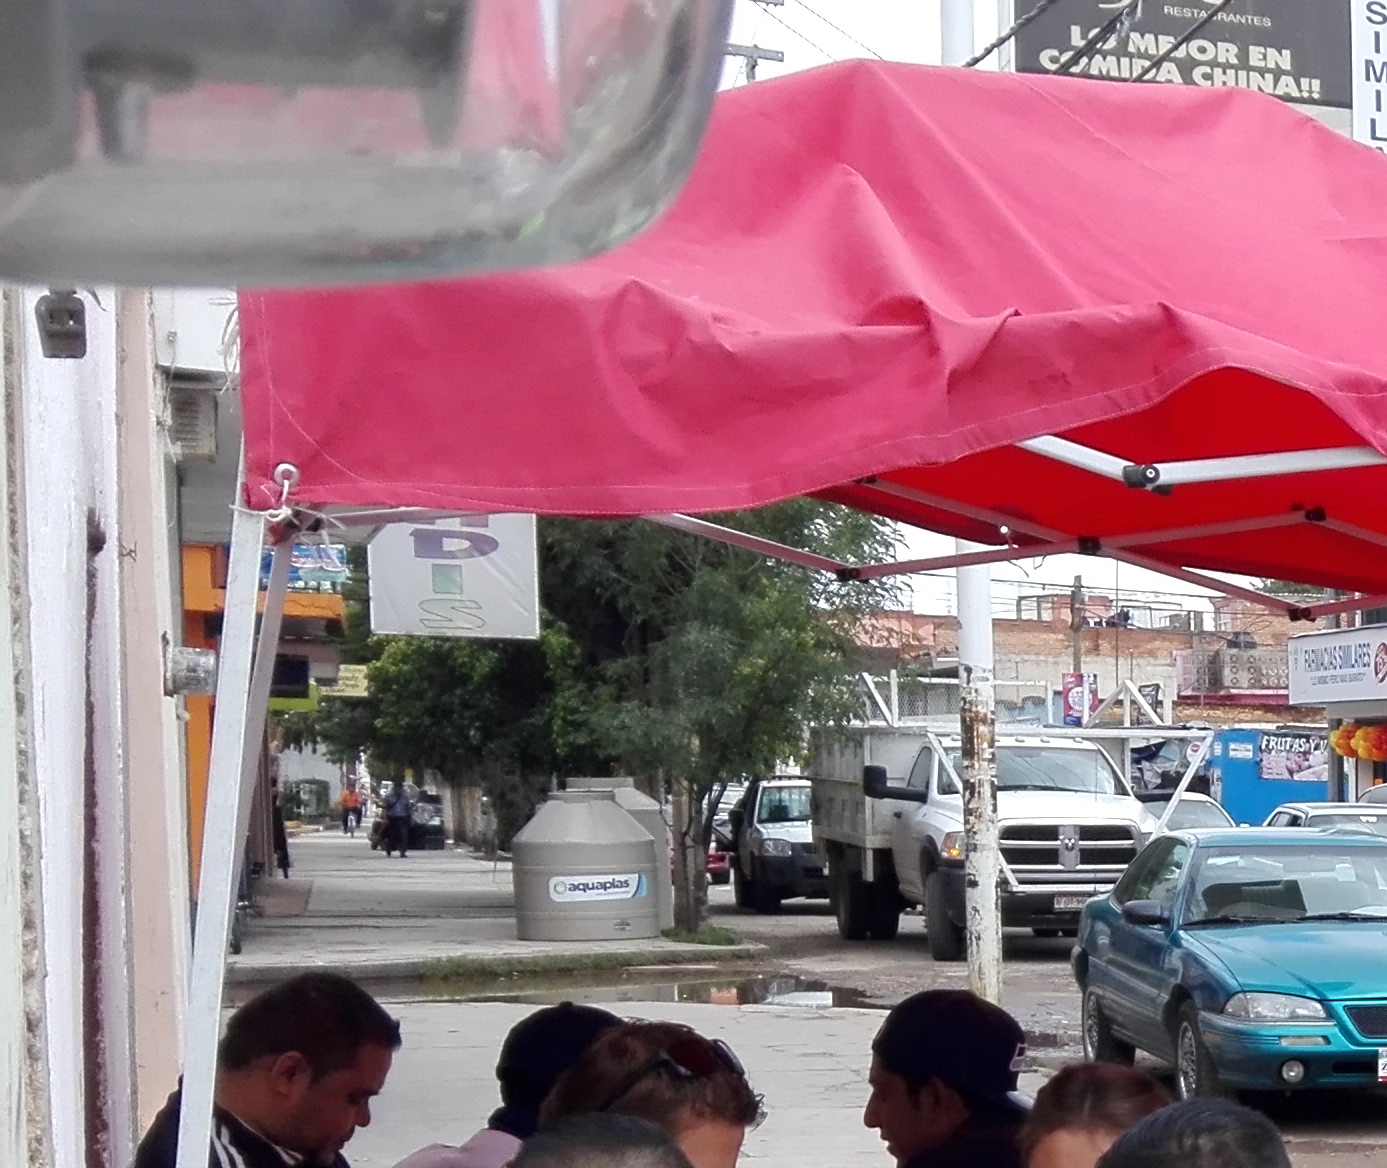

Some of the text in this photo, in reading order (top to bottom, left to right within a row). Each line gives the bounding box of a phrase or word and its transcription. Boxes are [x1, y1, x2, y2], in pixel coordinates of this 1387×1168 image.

[1163, 5, 1272, 27] RESTARANTES
[1248, 45, 1291, 70] EN
[1339, 642, 1370, 669] SIMILARES
[1261, 735, 1306, 752] FRUTAS
[1309, 739, 1317, 753] Y
[567, 878, 630, 893] aquaplas
